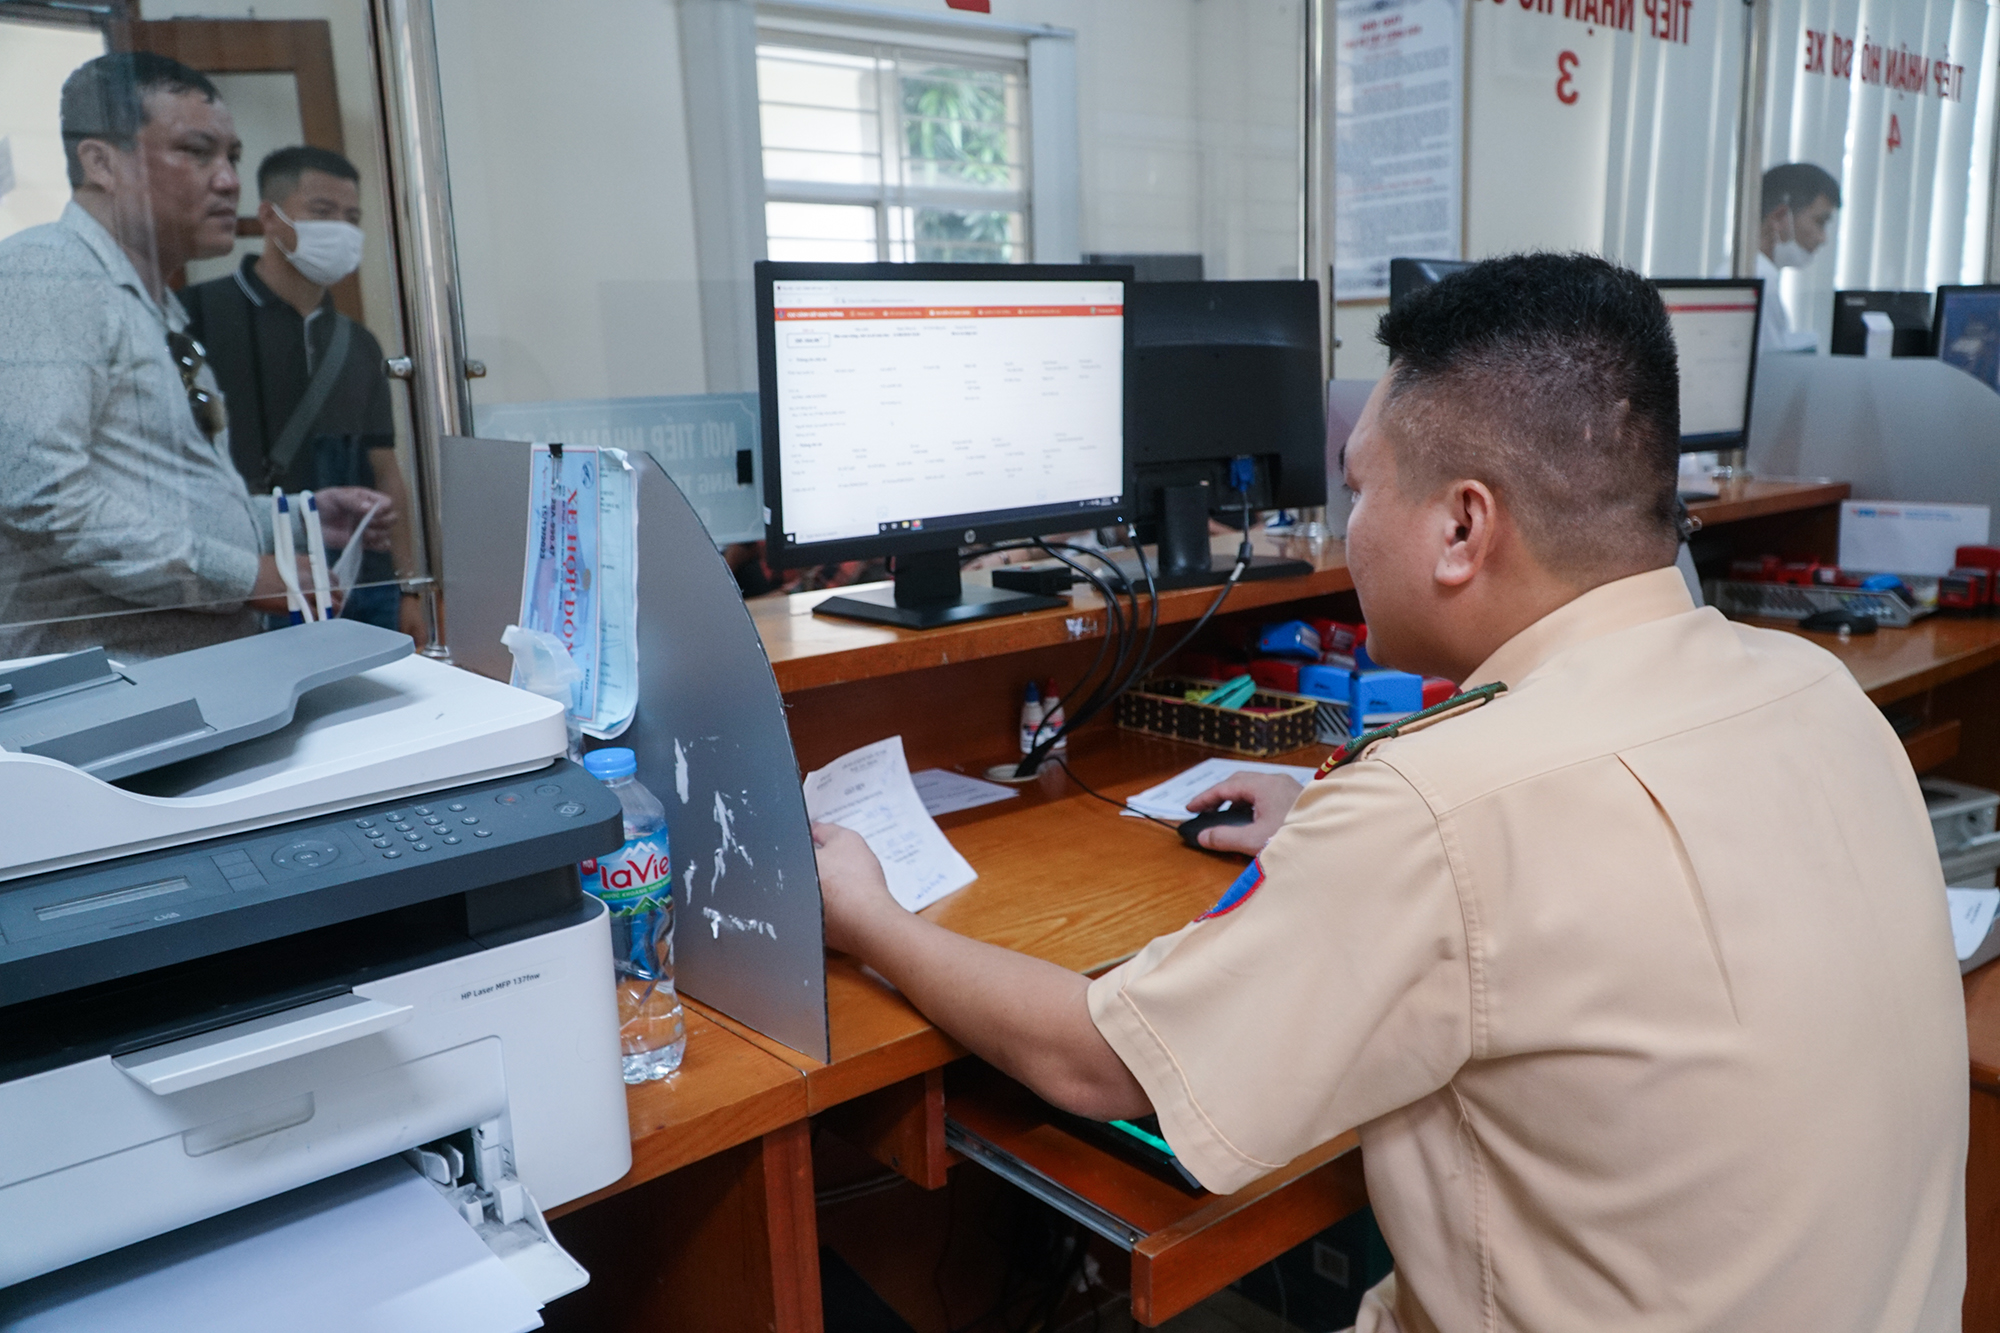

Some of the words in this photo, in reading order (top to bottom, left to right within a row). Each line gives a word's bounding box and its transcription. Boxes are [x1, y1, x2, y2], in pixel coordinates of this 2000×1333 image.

[567, 488, 577, 524] XE
[563, 534, 578, 591] HỢP
[600, 853, 669, 890] laVie
[460, 992, 472, 1000] HP
[473, 986, 494, 997] Laser
[495, 980, 511, 990] MFP
[513, 973, 541, 985] 137fnw
